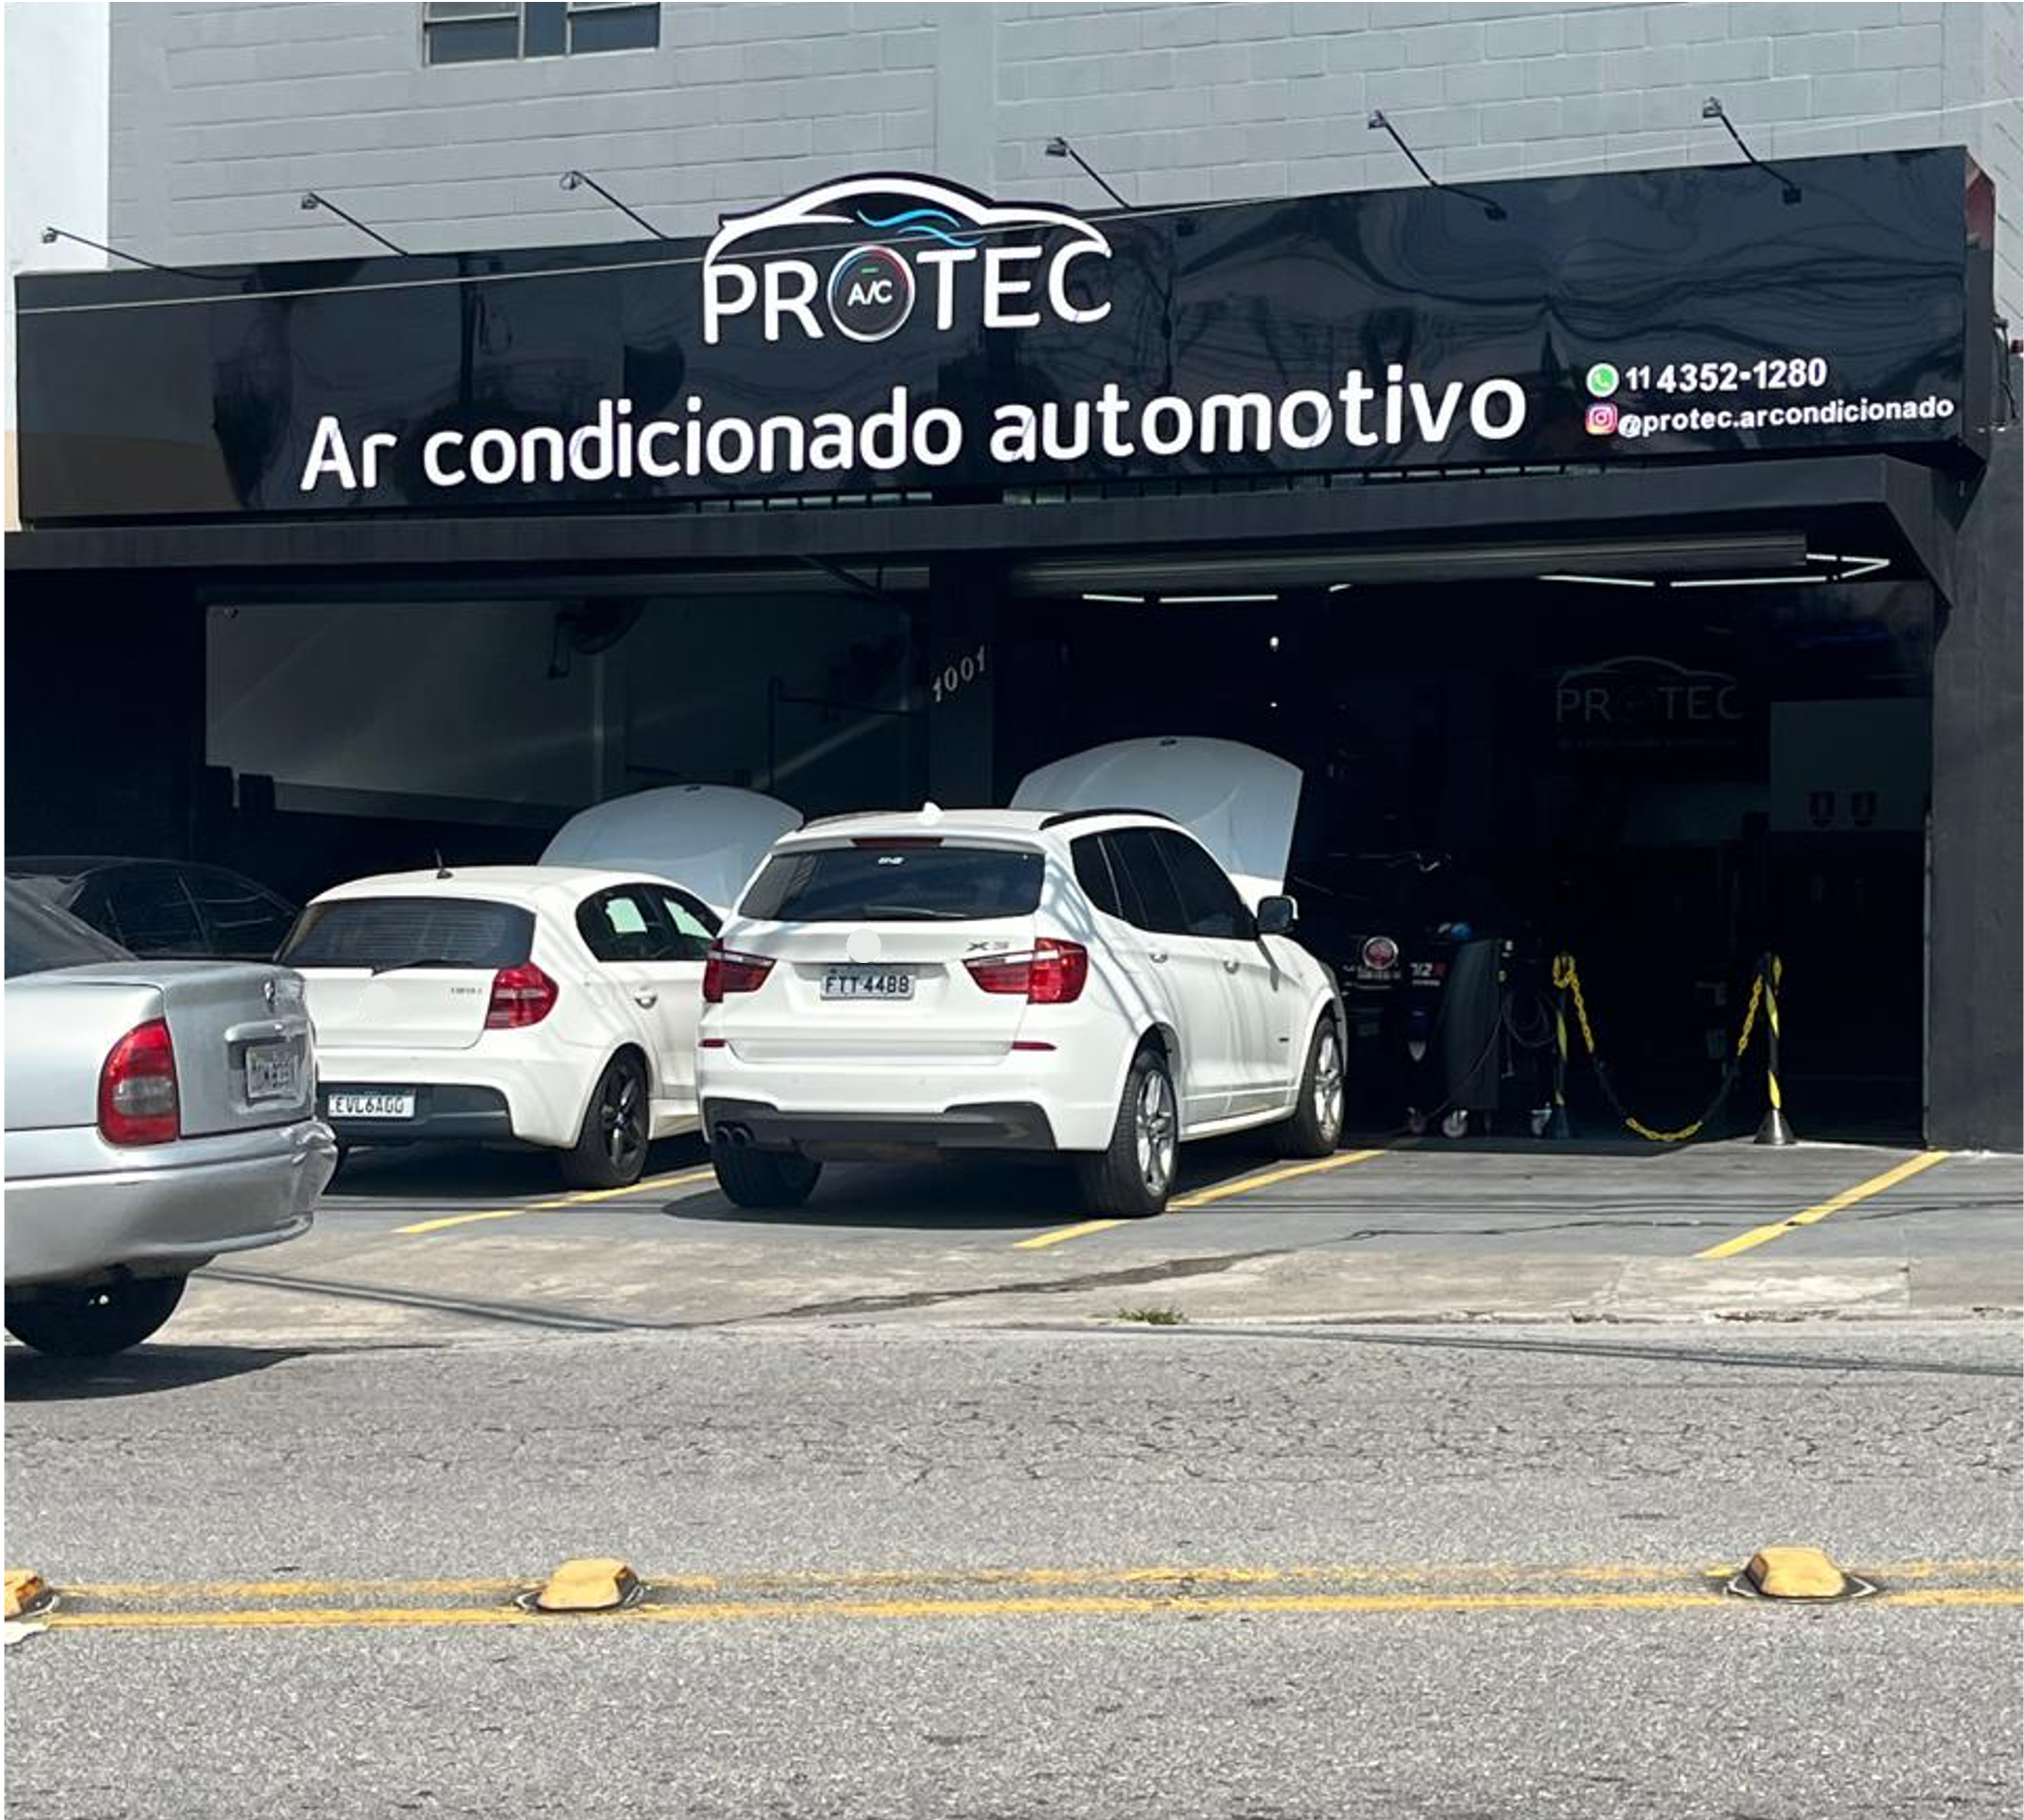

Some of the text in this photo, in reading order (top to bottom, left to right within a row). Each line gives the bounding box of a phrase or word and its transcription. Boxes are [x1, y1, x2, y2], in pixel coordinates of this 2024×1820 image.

[703, 239, 1113, 345] PROTEC
[847, 280, 892, 306] A/C
[1626, 357, 1826, 392] 11 4352-1280
[301, 364, 1525, 490] Ar condicionado automotivo
[1618, 396, 1953, 438] @protec.arcondicionado
[933, 645, 986, 702] 1001
